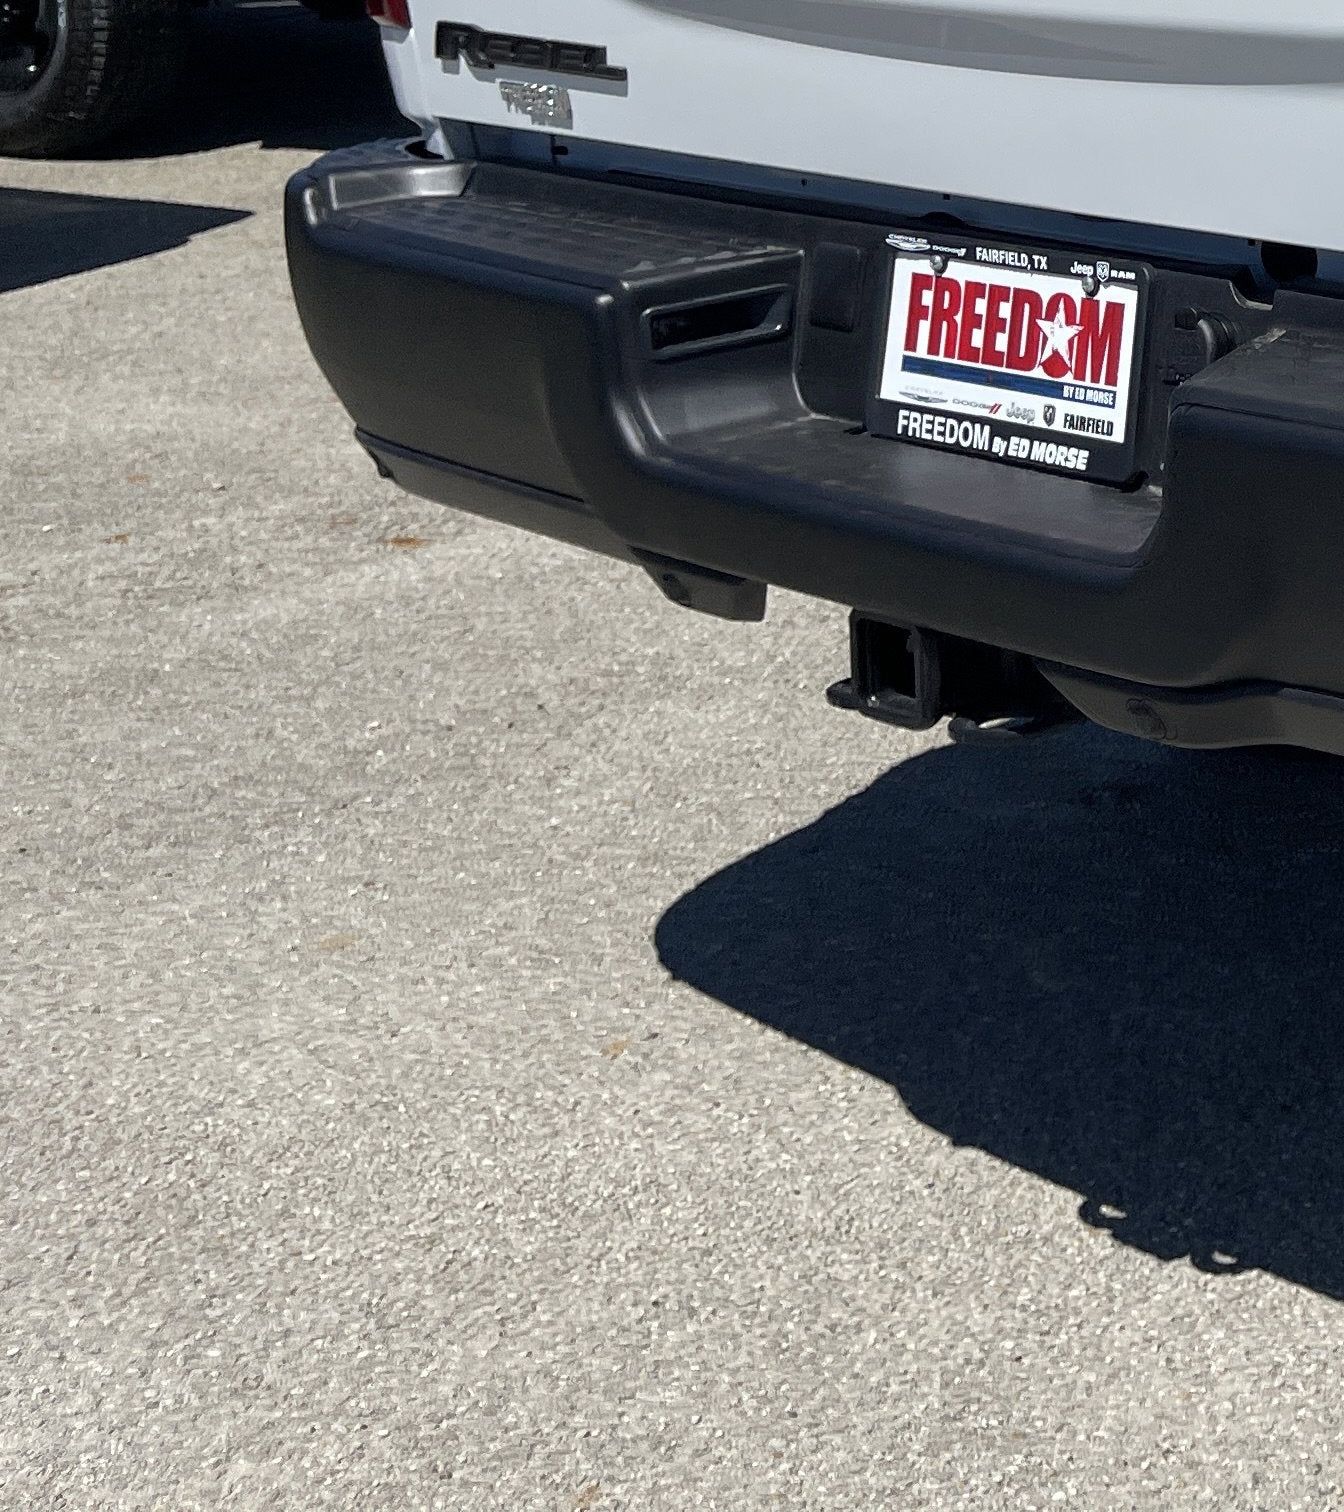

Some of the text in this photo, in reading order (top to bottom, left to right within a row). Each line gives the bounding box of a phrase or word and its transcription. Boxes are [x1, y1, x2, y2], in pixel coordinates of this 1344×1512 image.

[975, 246, 1048, 270] FAIRFIELD, TX
[1069, 260, 1094, 277] Jeep
[1110, 269, 1136, 281] RAM
[903, 271, 1125, 387] FREEDOM
[1062, 385, 1114, 406] BY ED MORSE
[1006, 401, 1036, 424] Jeep
[1063, 412, 1114, 437] FAIRFIELD
[897, 409, 991, 451] FREEDOM
[1007, 435, 1030, 459] ED
[1030, 440, 1090, 471] MORSE
